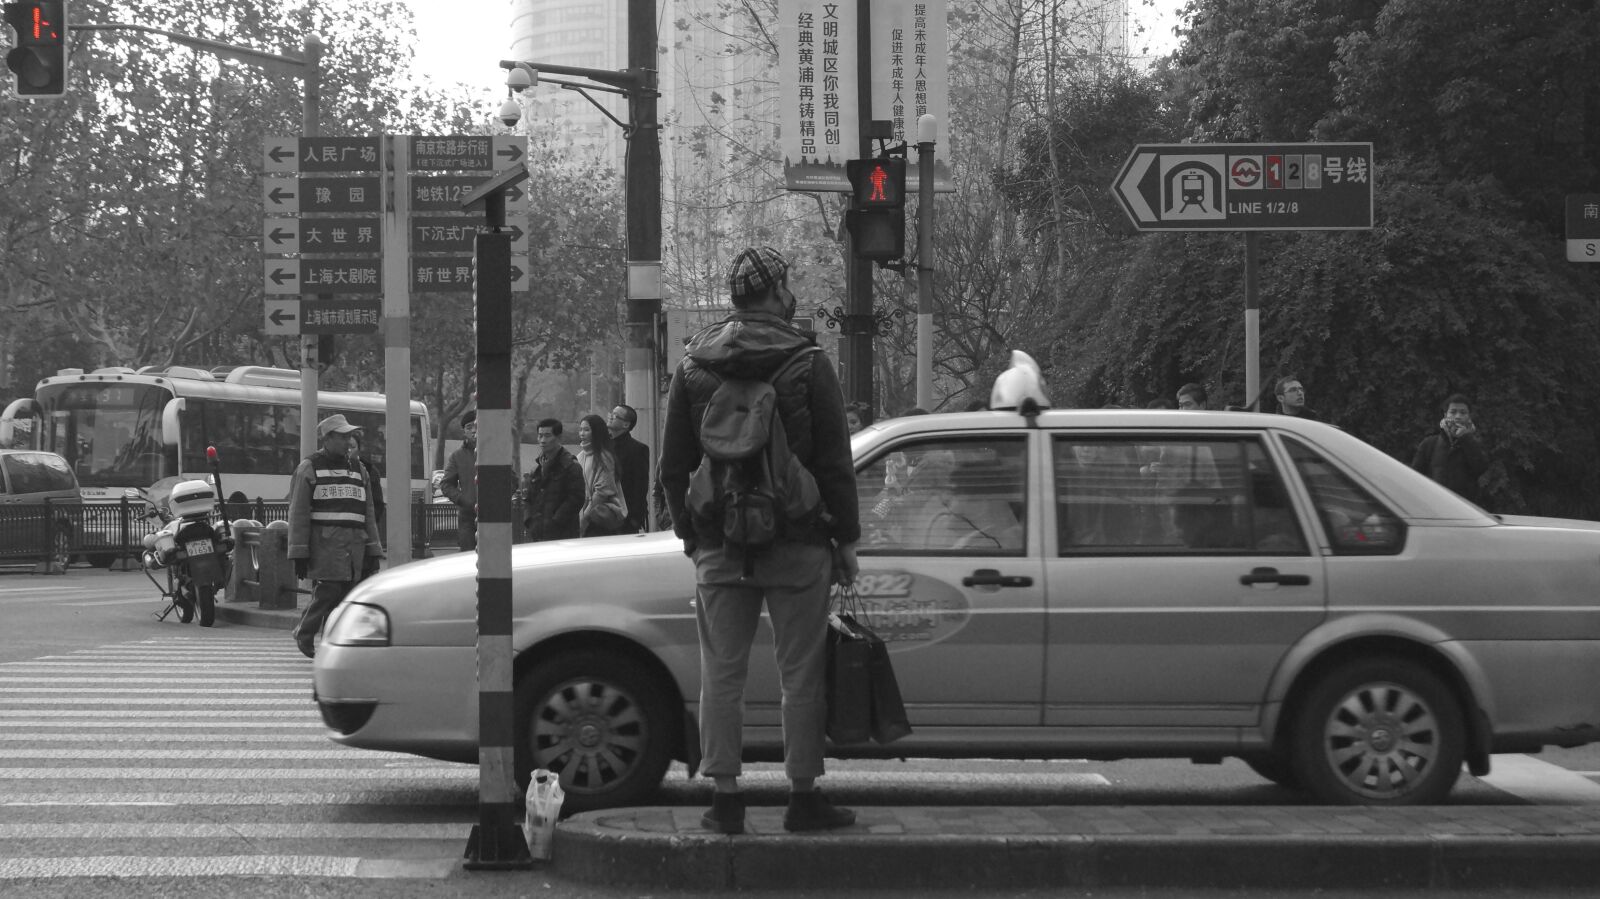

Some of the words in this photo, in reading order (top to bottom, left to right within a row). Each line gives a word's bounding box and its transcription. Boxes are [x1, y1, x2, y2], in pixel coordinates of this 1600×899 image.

[823, 2, 840, 145] 文明城区你我同创
[914, 3, 927, 128] 提高未成年人思想道
[798, 12, 816, 154] 经典黄浦再铸精品
[892, 28, 905, 147] 促进未成年人健康成
[304, 146, 376, 162] 人民广场
[416, 140, 488, 156] 南京东路步行街
[315, 187, 365, 203] 豫园
[1229, 202, 1262, 214] LINE
[1266, 202, 1299, 214] 1/2/8
[306, 227, 373, 243] 大世界
[304, 268, 377, 284] 上海大剧院
[417, 267, 470, 283] 新世界
[855, 573, 911, 597] 822
